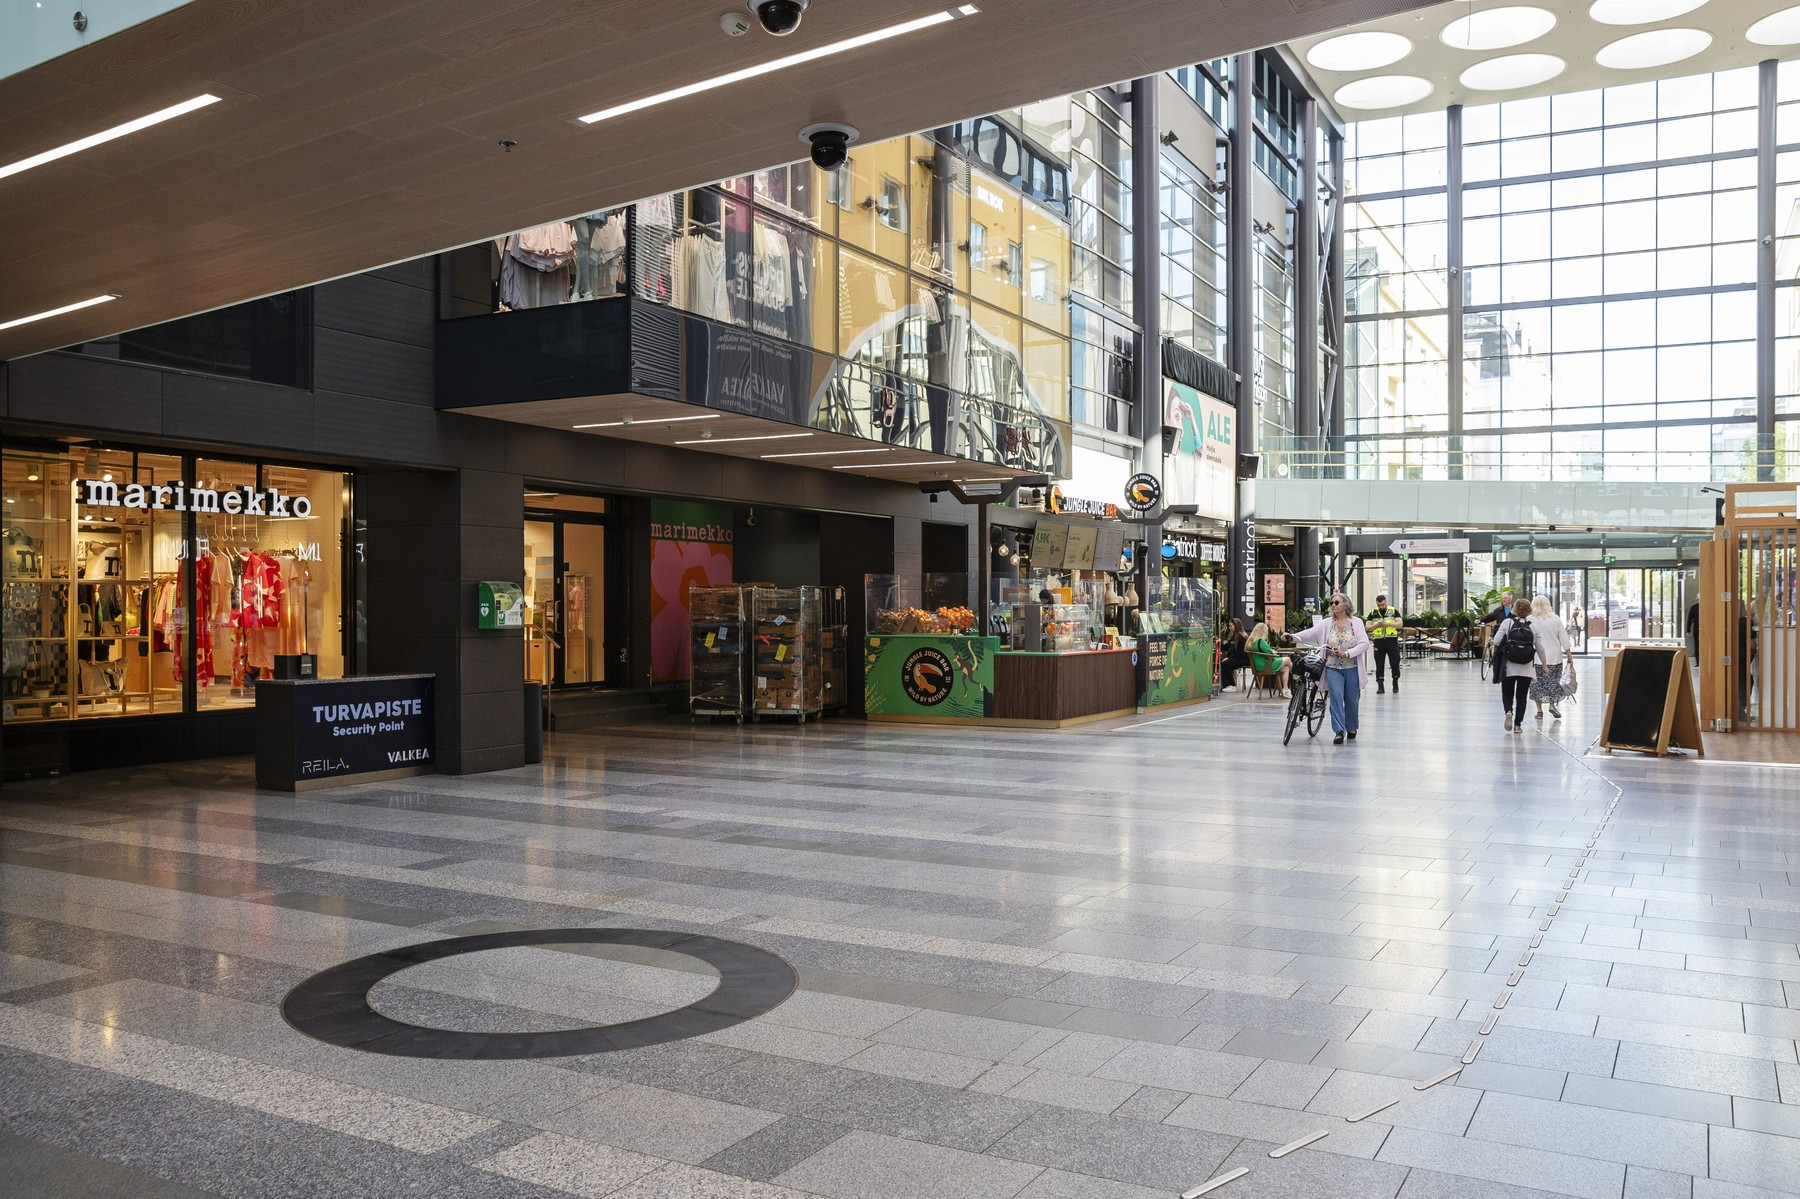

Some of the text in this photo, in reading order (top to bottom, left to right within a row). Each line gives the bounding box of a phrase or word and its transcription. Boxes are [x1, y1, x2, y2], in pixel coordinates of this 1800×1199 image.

[1207, 410, 1231, 446] ALE
[86, 480, 312, 518] marimekko
[1063, 496, 1117, 517] JUNGLE JUICE BAR
[650, 522, 733, 542] marimekko
[1241, 518, 1255, 617] ainatricot
[1149, 641, 1167, 653] FEEL THE
[905, 650, 949, 671] JUNGLE JUICE BAR
[1149, 655, 1167, 667] FORCE OF
[1149, 669, 1163, 681] NATURE
[908, 687, 947, 703] WILD BY NATURE
[312, 699, 422, 723] TURVAPISTE
[333, 720, 405, 737] Security Point
[387, 748, 430, 763] VALKEA
